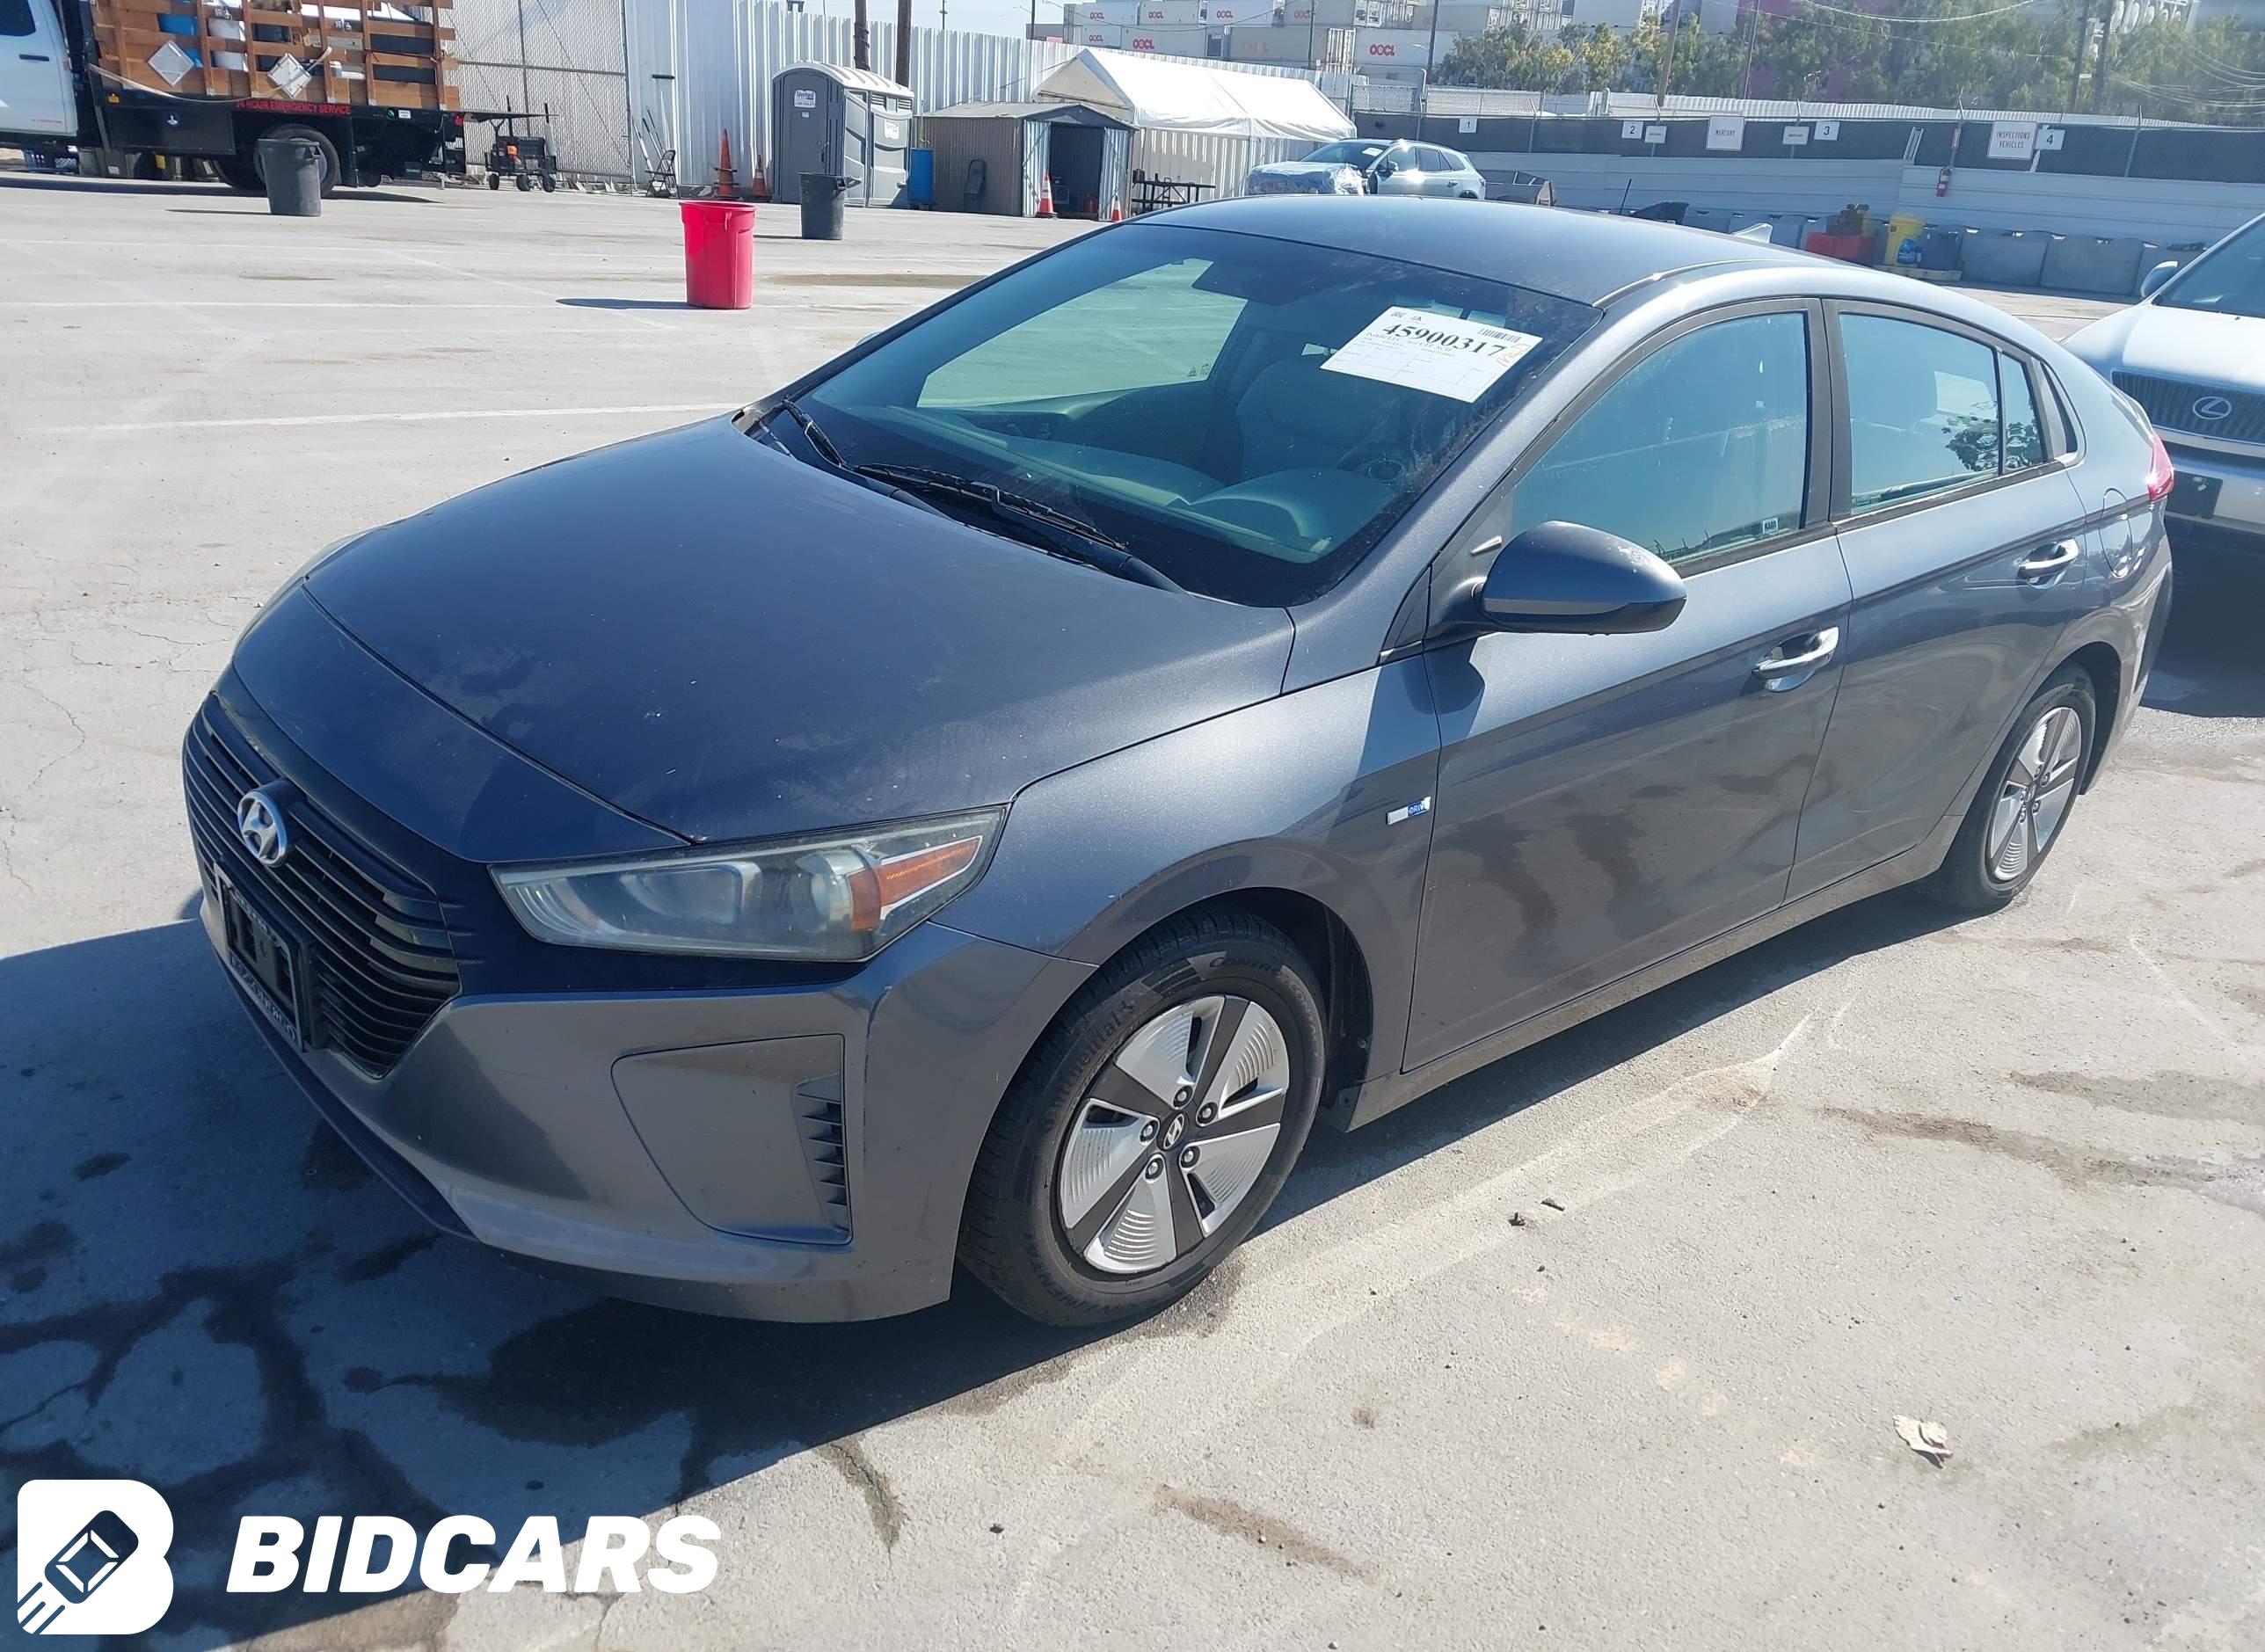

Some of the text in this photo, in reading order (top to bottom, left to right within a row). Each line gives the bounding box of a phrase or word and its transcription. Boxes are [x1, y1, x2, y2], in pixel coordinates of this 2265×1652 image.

[1089, 11, 1104, 20] OOCL
[1147, 11, 1164, 19] OOCL
[1216, 10, 1234, 18] OOCL
[1294, 10, 1311, 18] OOC
[1132, 39, 1154, 49] OOCL
[1370, 44, 1395, 56] OOCL
[246, 99, 269, 111] HOUR
[270, 100, 317, 113] EMERGENCY
[318, 104, 351, 114] SERVICE
[1629, 126, 1635, 135] 2
[1823, 127, 1830, 135] 3
[2046, 134, 2054, 145] 4
[1382, 324, 1507, 357] 45900317
